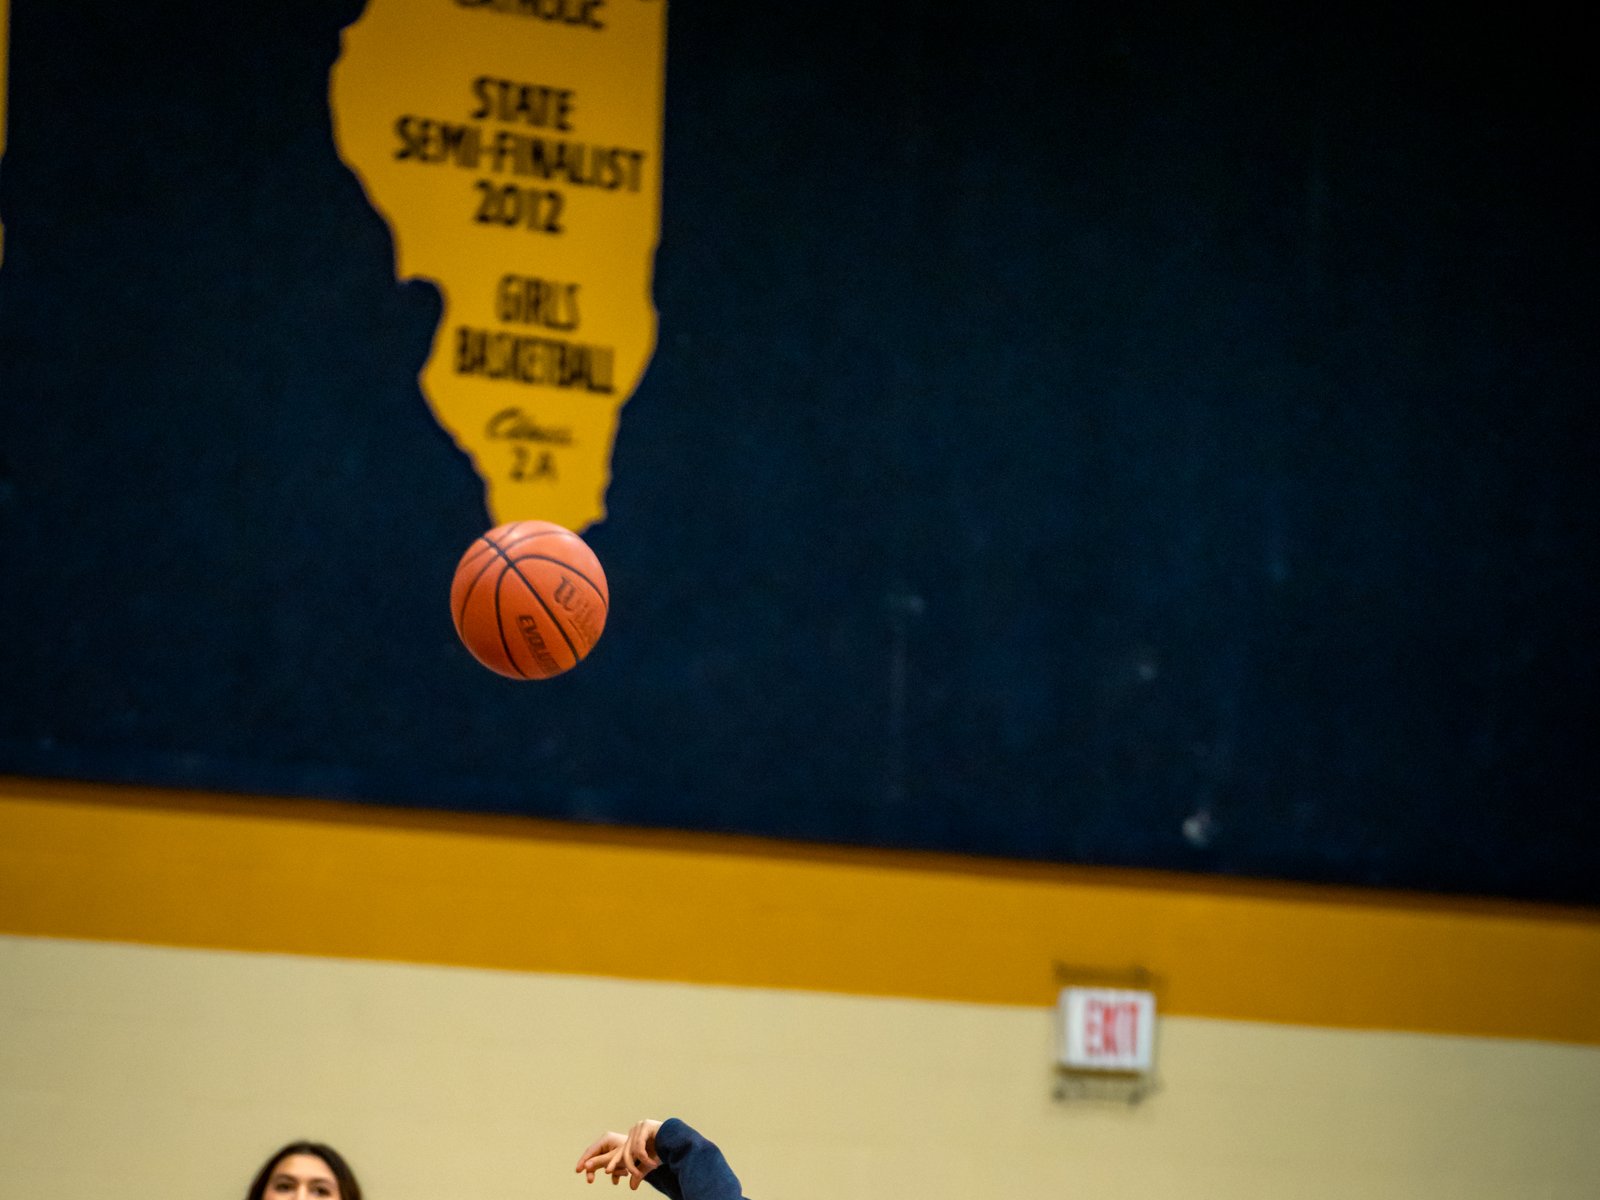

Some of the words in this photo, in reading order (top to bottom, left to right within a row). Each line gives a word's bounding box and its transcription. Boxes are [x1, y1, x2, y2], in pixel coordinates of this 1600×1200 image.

[472, 75, 574, 133] STATE
[396, 115, 645, 193] SEMI-FINALIST
[475, 180, 563, 234] 2012
[498, 274, 580, 331] GIRLS
[457, 325, 616, 395] BASKETBALL
[1085, 999, 1139, 1057] EXIT
